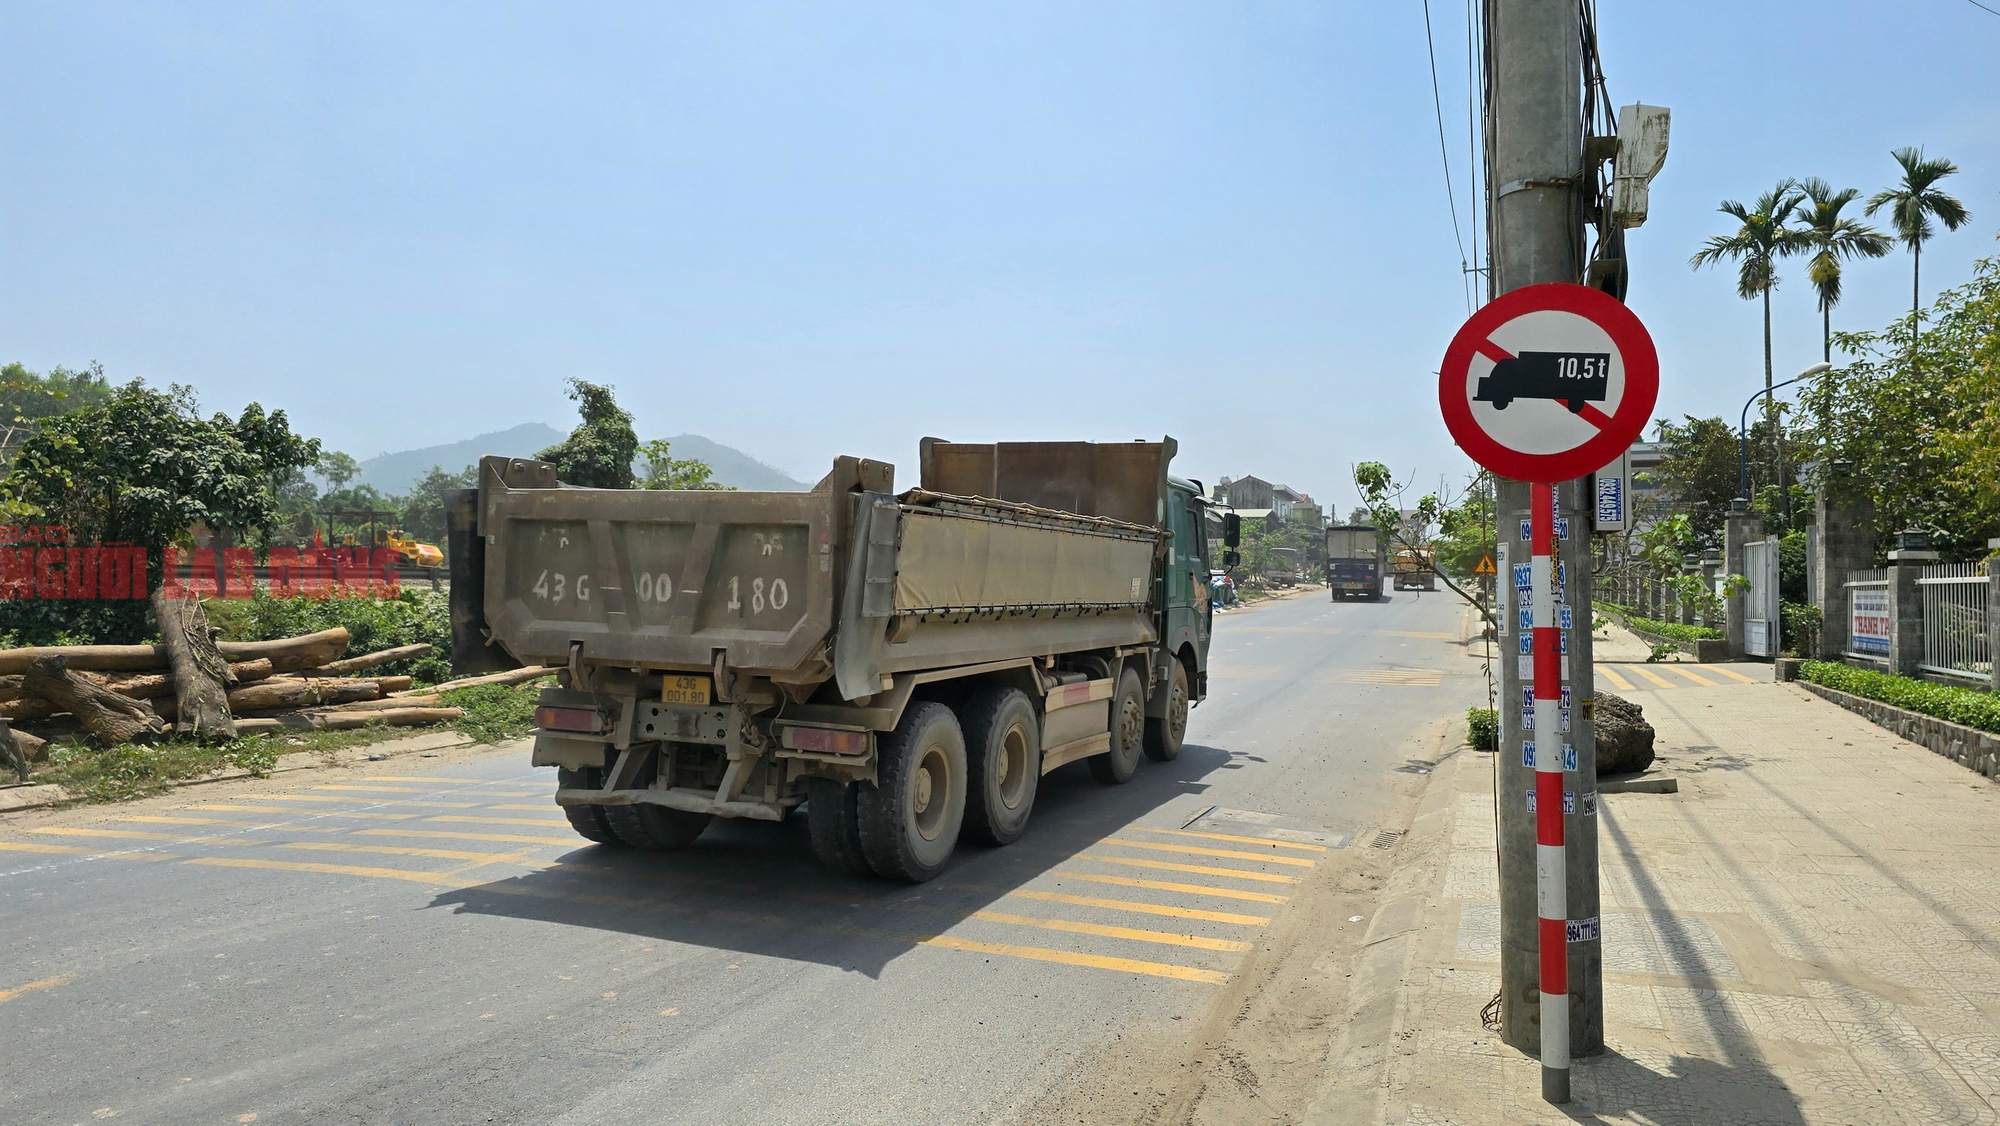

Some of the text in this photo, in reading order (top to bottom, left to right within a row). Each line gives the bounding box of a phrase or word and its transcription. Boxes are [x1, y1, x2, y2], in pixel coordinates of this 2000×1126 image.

[1558, 357, 1606, 380] 10,5 t
[727, 576, 788, 614] 180
[675, 677, 697, 690] 43G
[667, 690, 705, 703] 001.80
